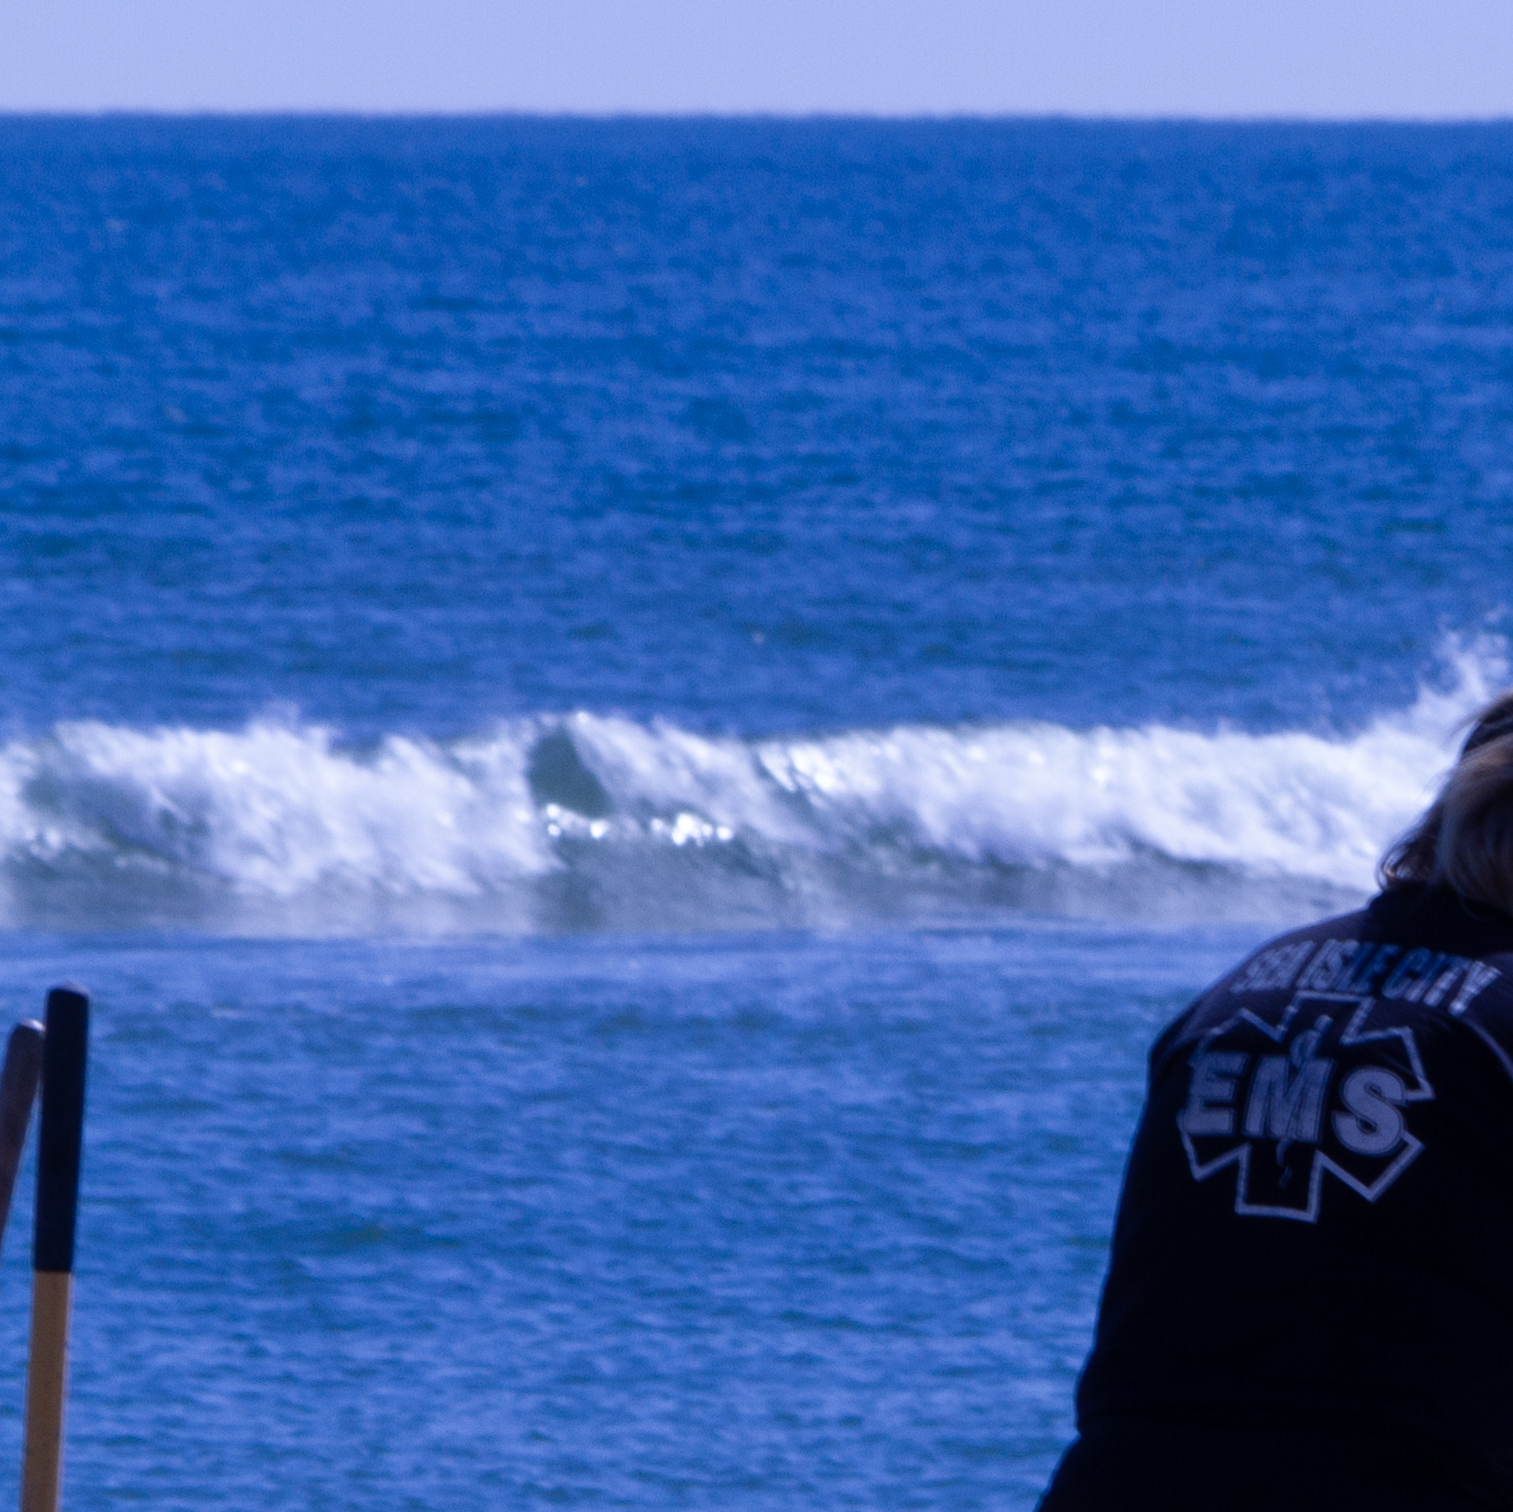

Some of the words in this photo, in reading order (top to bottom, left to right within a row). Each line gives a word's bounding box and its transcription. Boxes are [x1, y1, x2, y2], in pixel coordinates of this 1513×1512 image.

[1295, 938, 1402, 994] ISLE
[1381, 947, 1503, 1018] CITY
[1182, 1050, 1407, 1157] EMS
